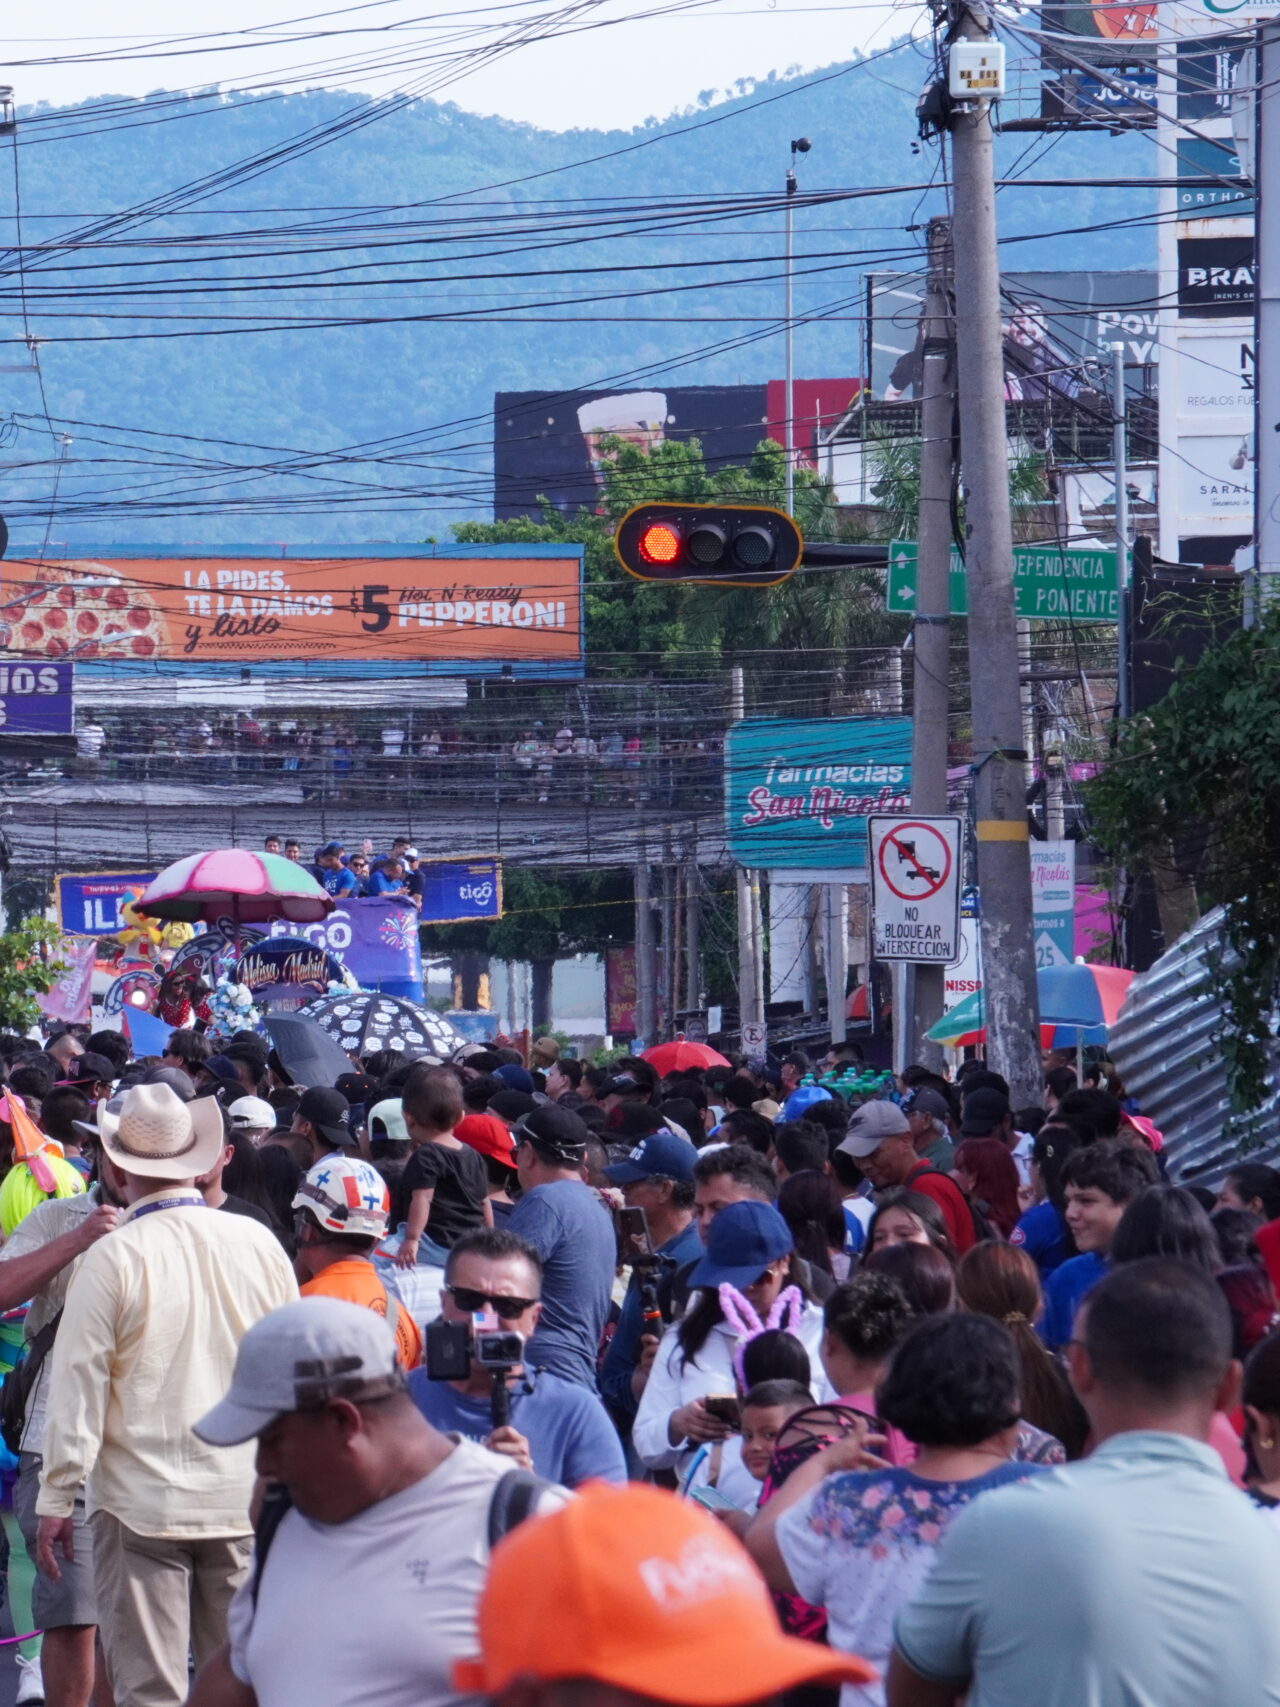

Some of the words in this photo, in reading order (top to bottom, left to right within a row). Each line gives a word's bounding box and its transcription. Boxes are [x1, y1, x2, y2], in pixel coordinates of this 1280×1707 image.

[184, 570, 212, 591] LA
[184, 595, 211, 616] TE
[217, 595, 248, 616] LA
[251, 594, 335, 617] DAMOS
[1036, 588, 1118, 615] PONIENTE
[208, 612, 282, 637] listo
[398, 601, 566, 628] PEPPERONI
[743, 785, 806, 825] San
[904, 906, 919, 922] NO
[884, 923, 942, 940] BLOQUEAR
